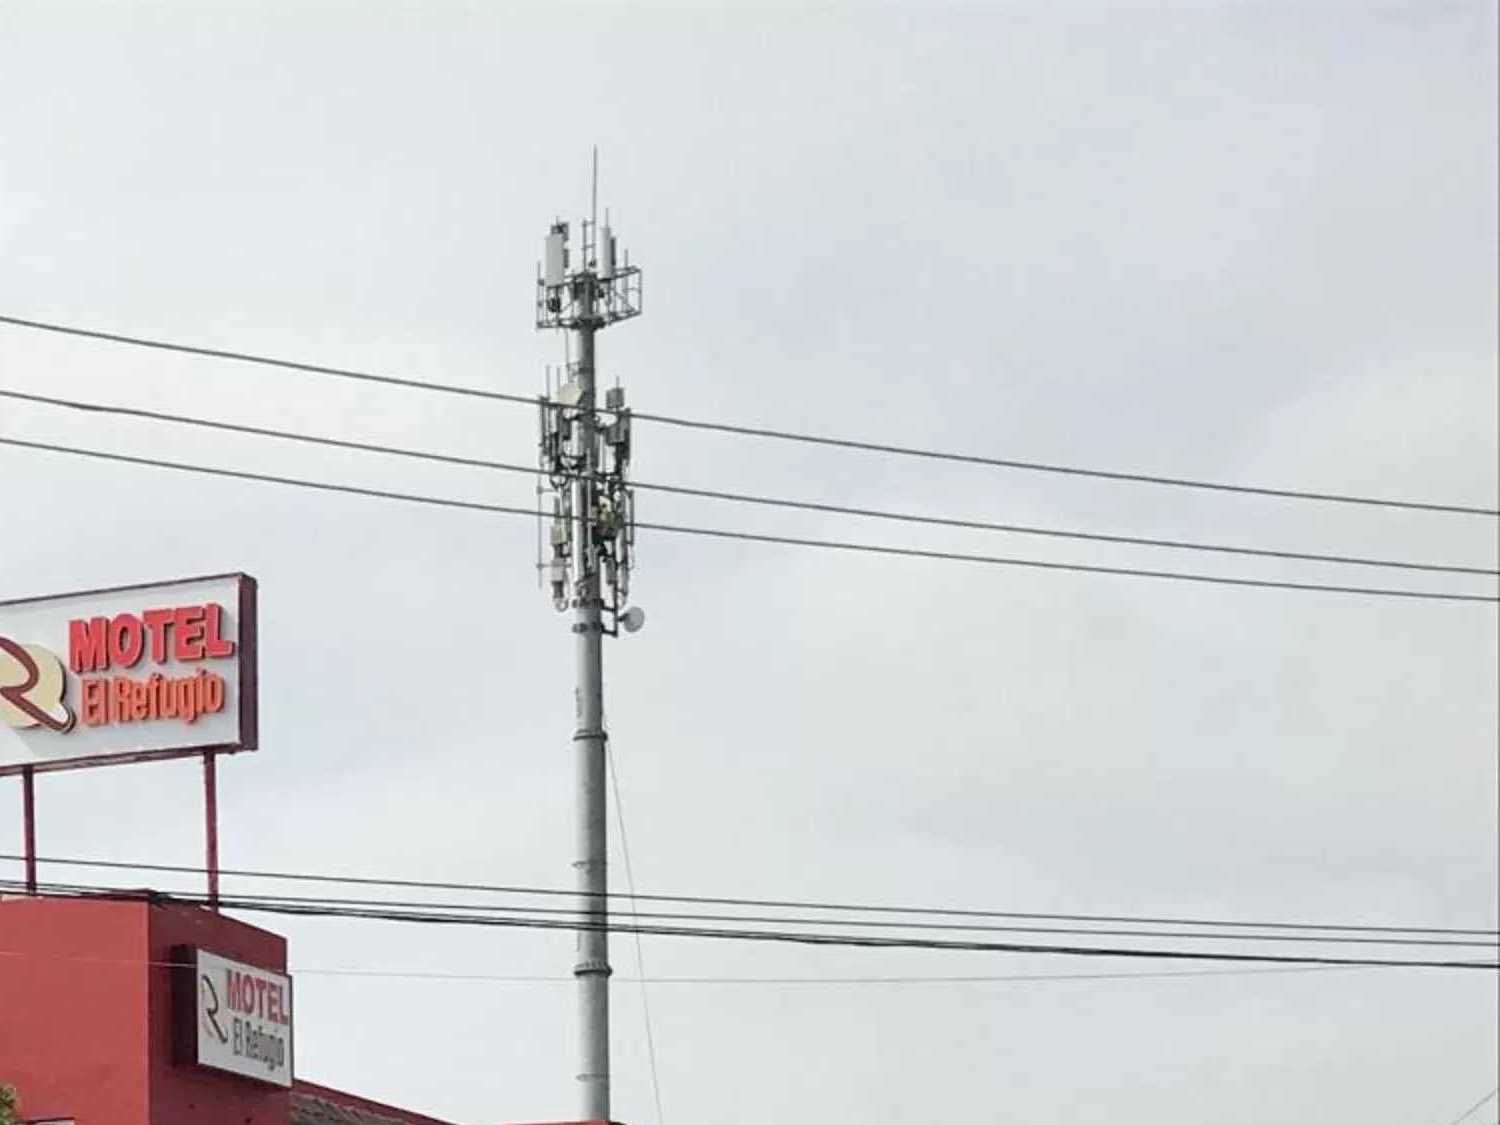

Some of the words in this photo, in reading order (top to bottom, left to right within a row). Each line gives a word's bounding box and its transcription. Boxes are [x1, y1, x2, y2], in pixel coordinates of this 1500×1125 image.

[68, 603, 235, 673] MOTEL
[80, 678, 108, 727] El
[114, 669, 224, 724] Refugio
[226, 967, 289, 1026] MOTEL
